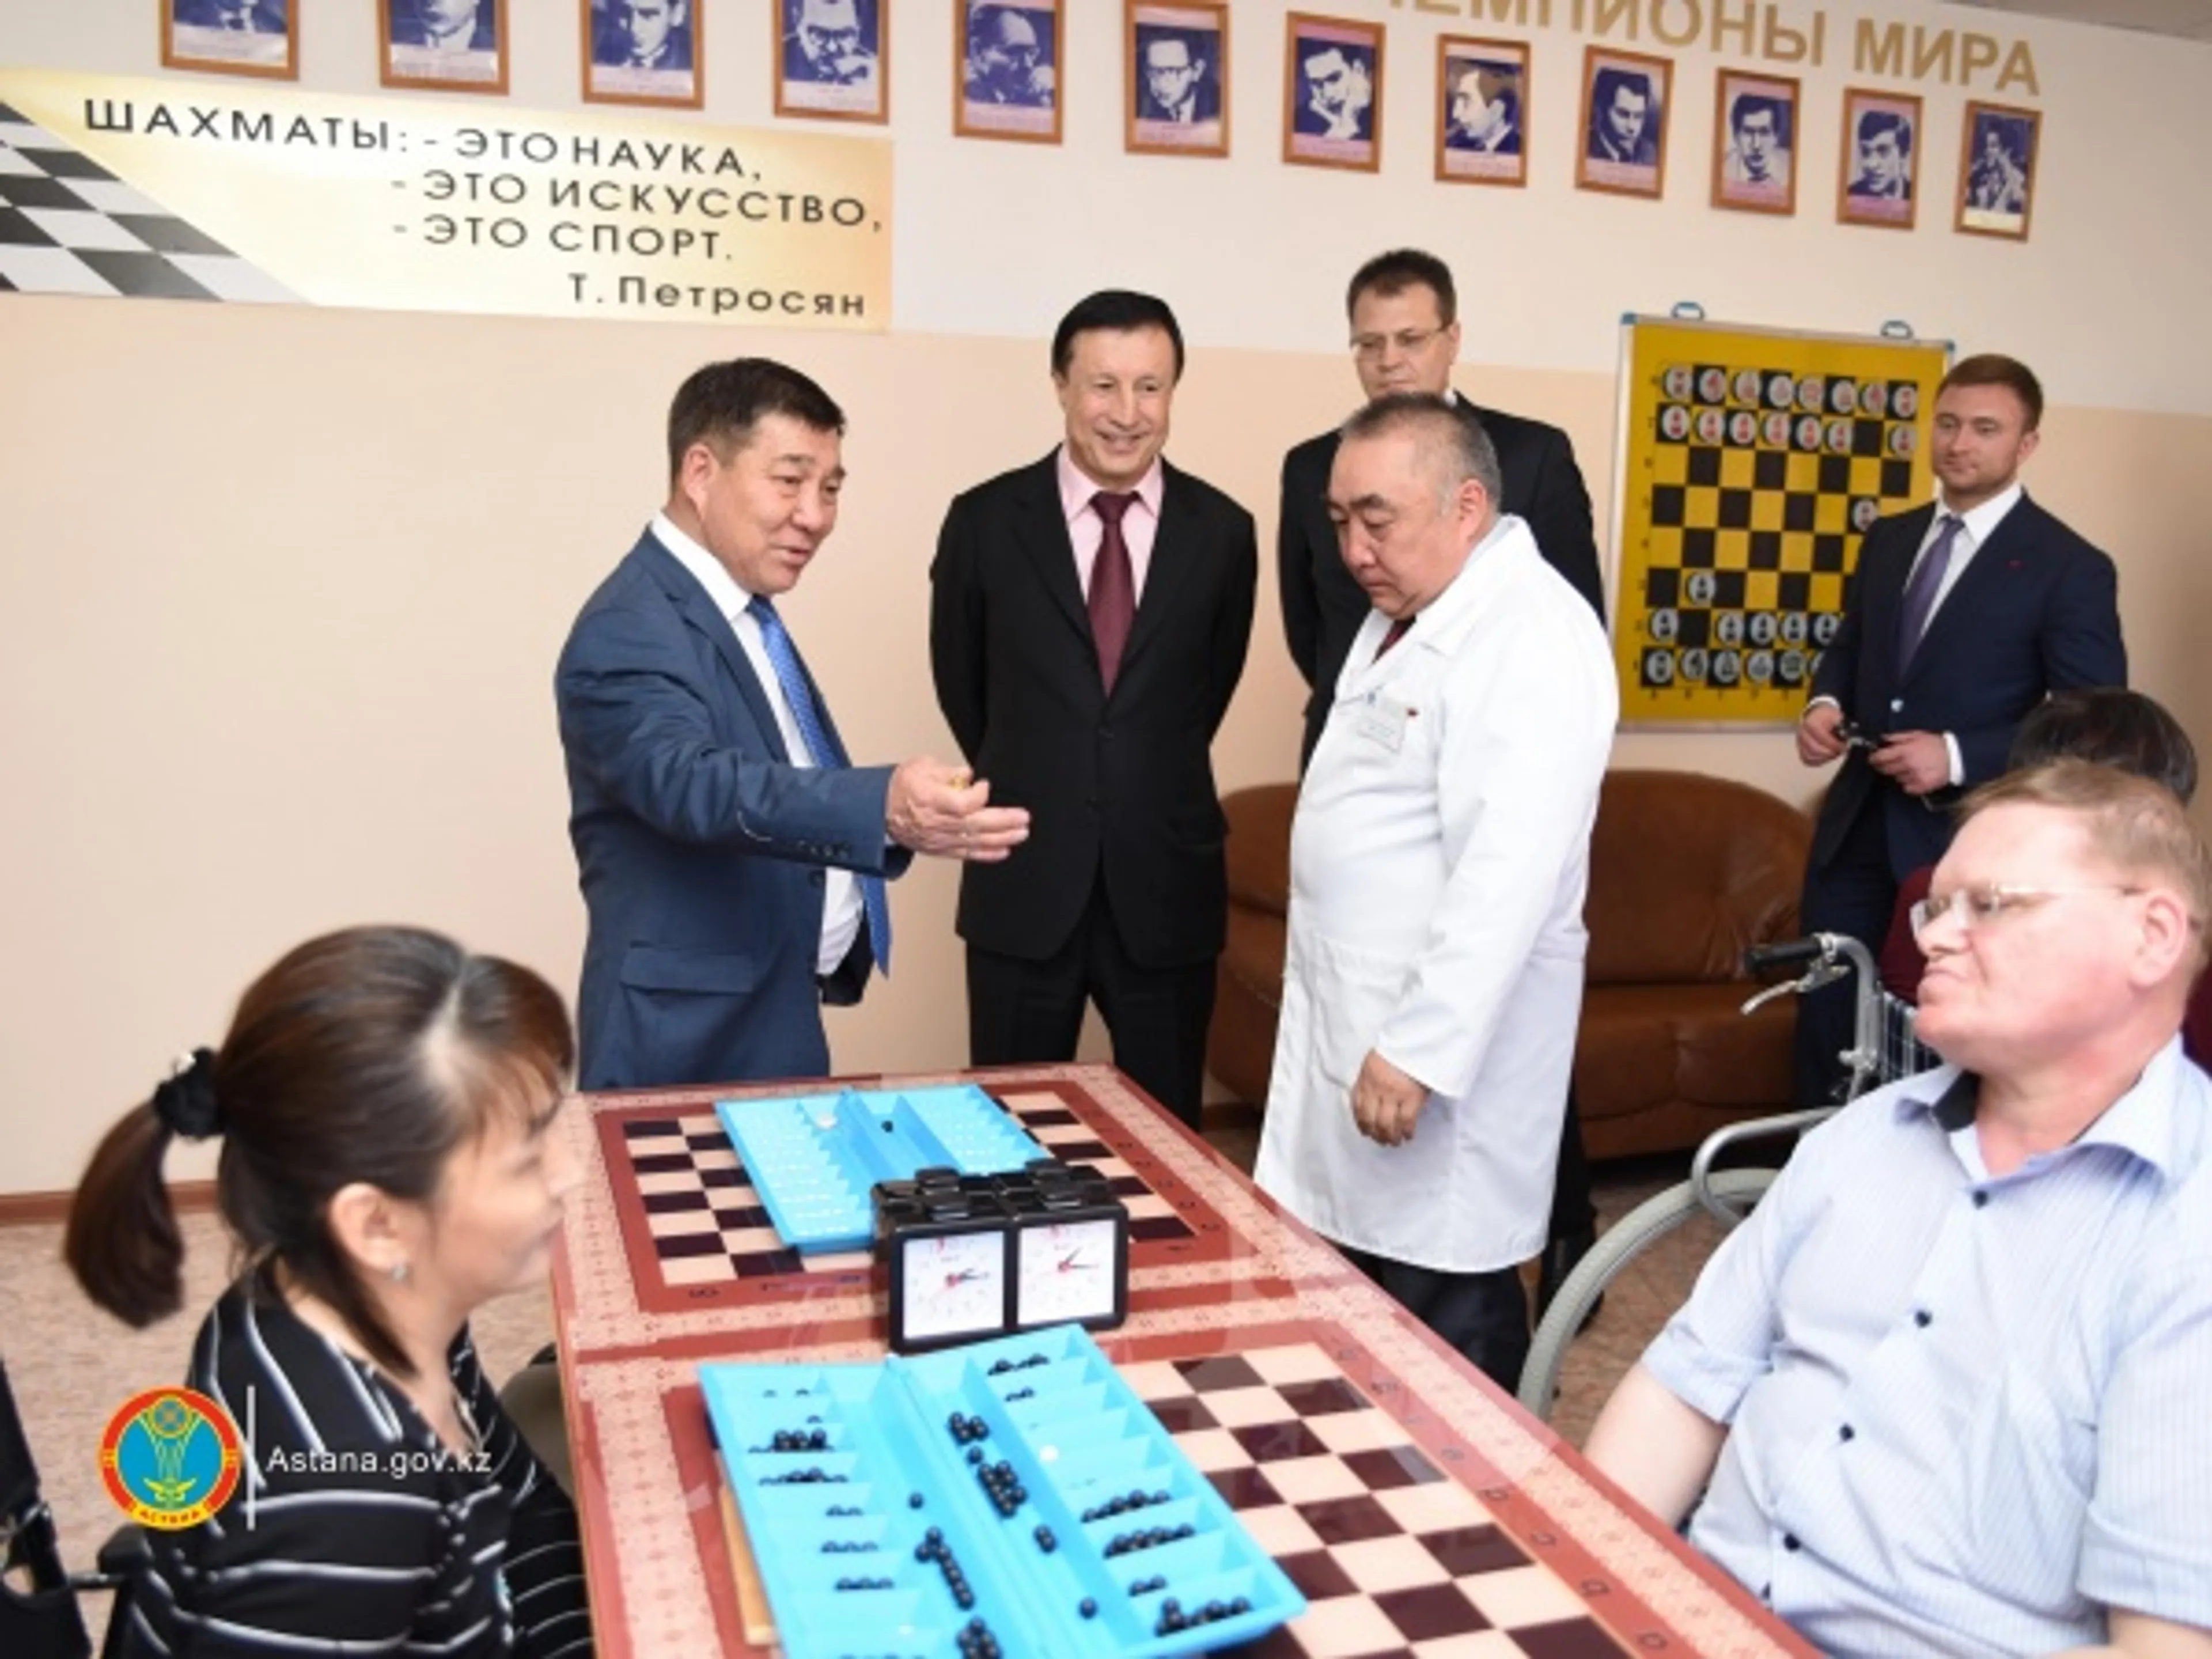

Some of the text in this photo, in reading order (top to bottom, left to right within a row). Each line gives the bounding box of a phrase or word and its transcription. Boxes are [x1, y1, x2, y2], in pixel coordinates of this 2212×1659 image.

[1853, 18, 2040, 96] МИРА
[85, 99, 407, 151] ШАХМАТЫ:
[455, 128, 558, 162] ЭТО
[572, 137, 761, 181] НАУКА,
[423, 170, 527, 203] ЭТО
[550, 179, 881, 232] ИСКУССТВО,
[423, 214, 527, 248] ЭТО
[549, 222, 732, 260] СПОРТ.
[619, 276, 865, 315] Петросян
